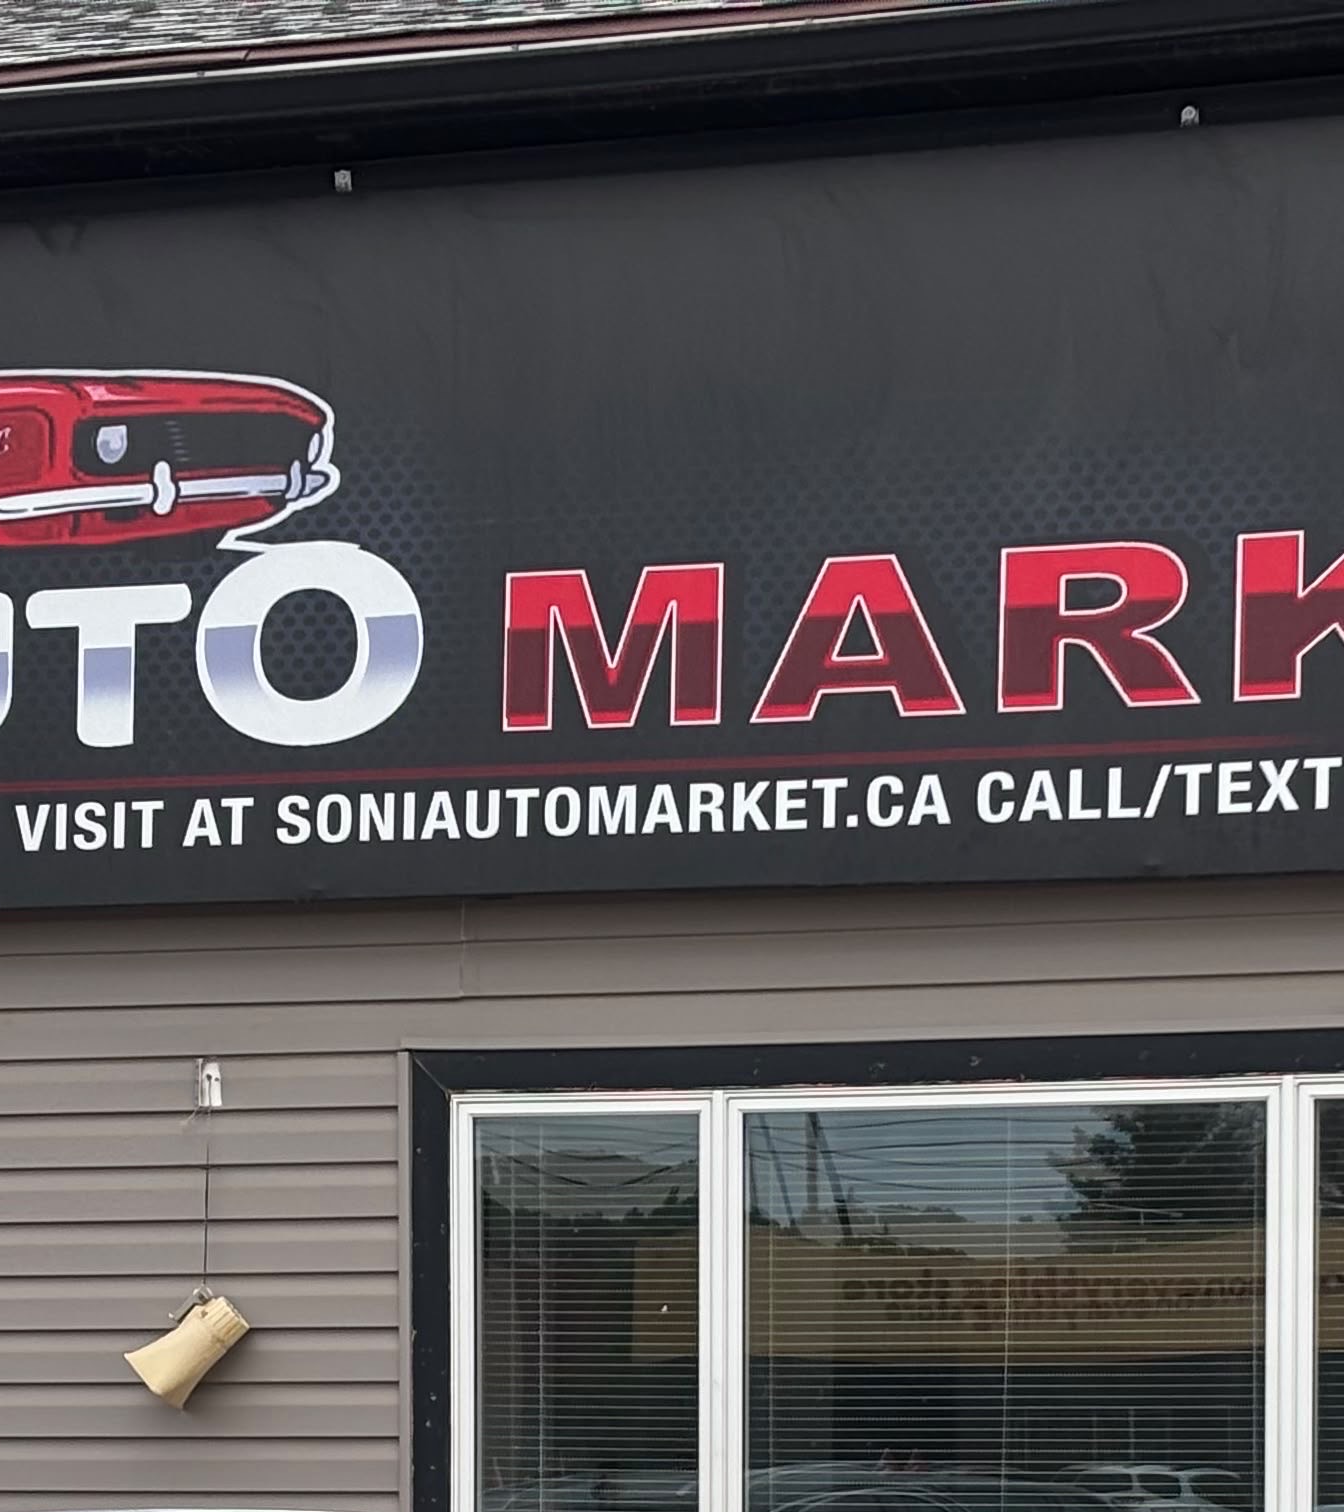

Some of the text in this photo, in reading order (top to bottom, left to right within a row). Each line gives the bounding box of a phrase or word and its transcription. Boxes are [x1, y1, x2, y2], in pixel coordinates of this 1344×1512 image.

[15, 798, 165, 852] VISIT
[182, 796, 255, 847] AT
[276, 773, 952, 845] SONIAUTOMARKET.CA
[976, 756, 1343, 824] CALL/TEXT
